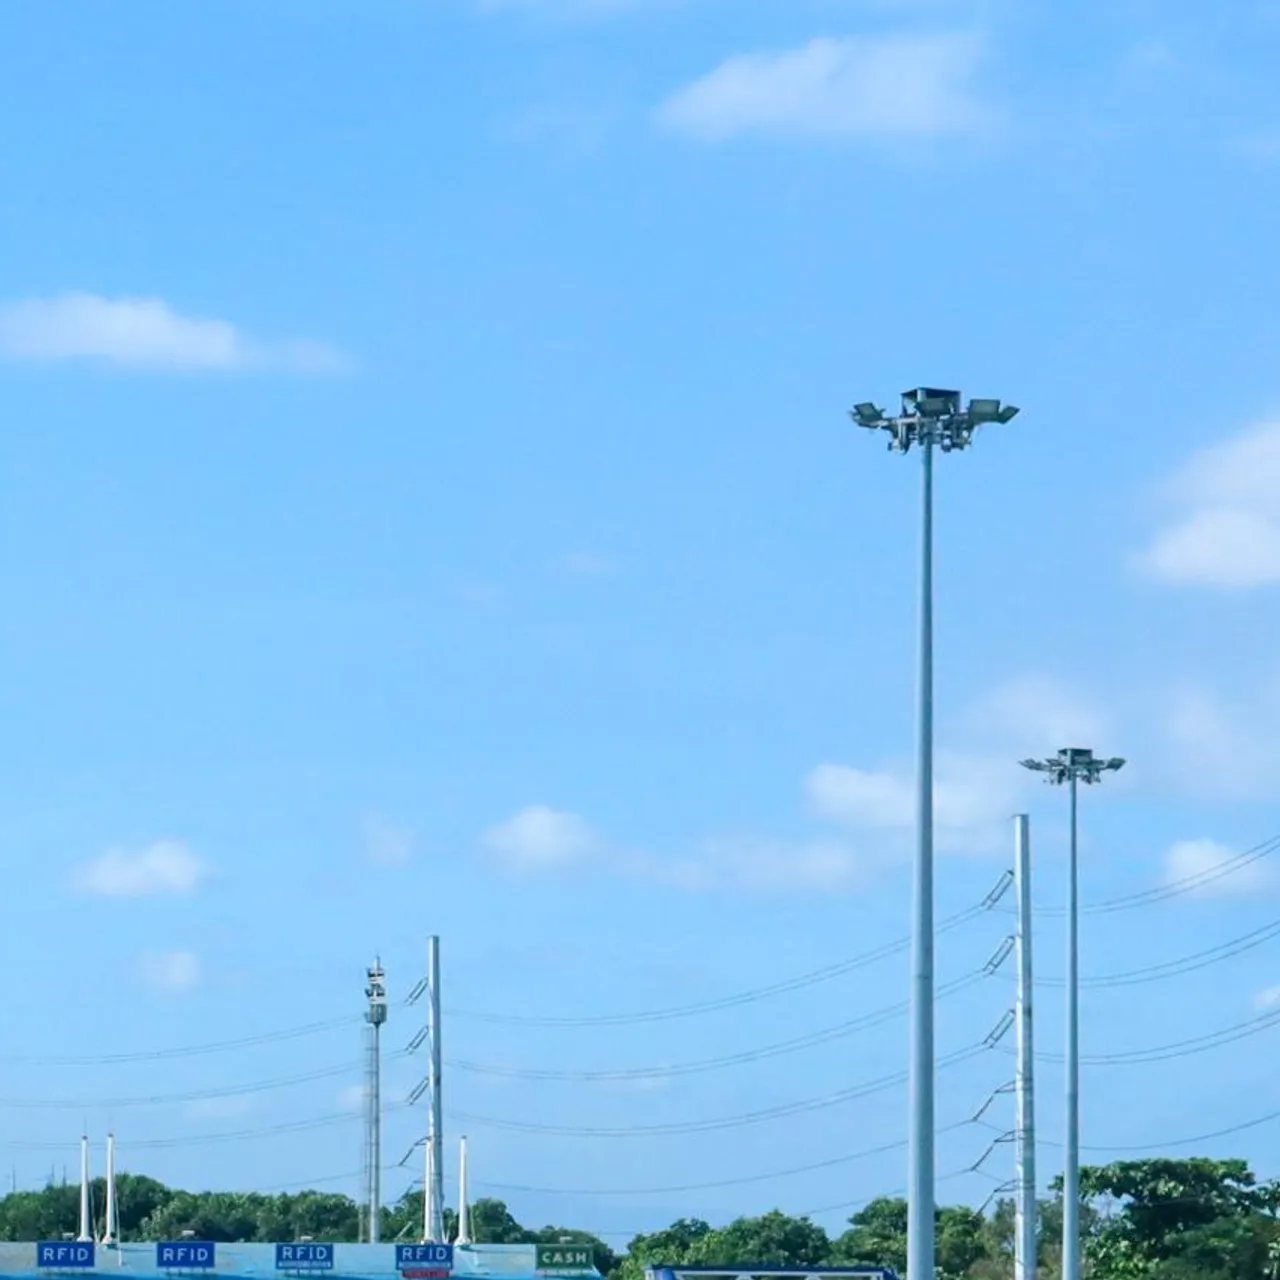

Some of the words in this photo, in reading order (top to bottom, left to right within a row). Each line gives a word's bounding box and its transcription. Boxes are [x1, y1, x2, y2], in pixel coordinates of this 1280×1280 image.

[43, 1247, 89, 1261] RFID
[163, 1247, 209, 1261] RFID
[282, 1246, 327, 1260] RFID
[402, 1246, 447, 1260] RFID
[542, 1252, 587, 1264] CASH
